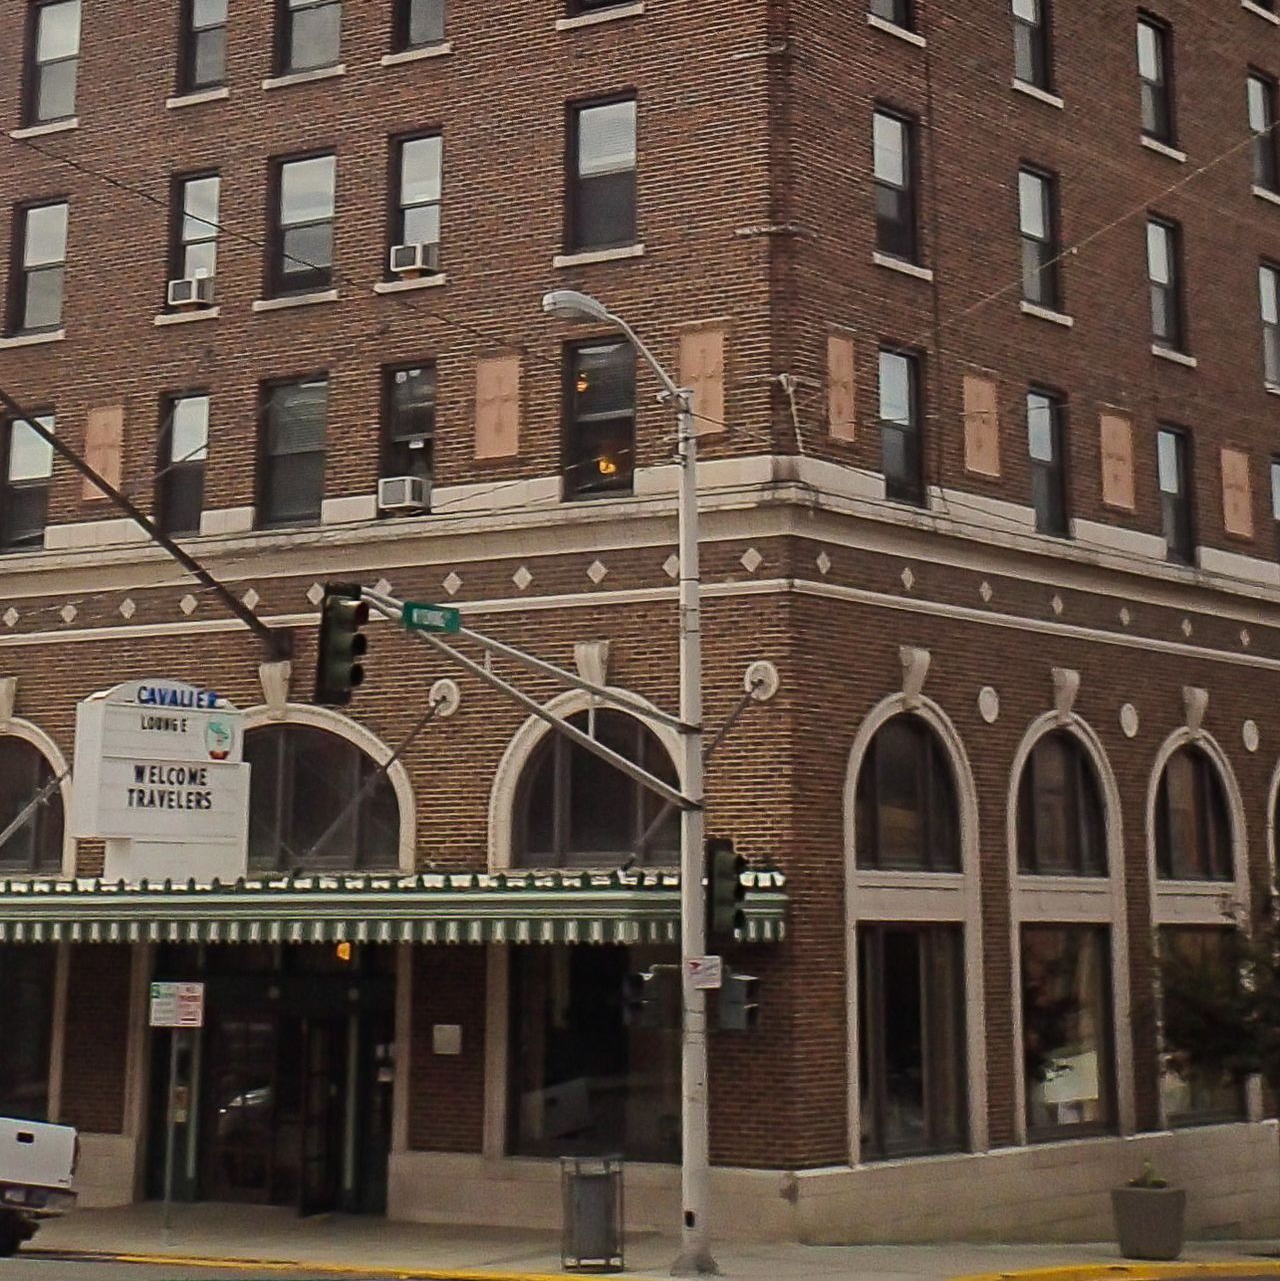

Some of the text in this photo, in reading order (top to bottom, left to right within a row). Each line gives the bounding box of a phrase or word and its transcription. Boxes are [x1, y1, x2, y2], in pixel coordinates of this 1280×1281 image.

[141, 715, 188, 732] LOUNGE
[135, 765, 207, 786] WELCOME
[128, 789, 212, 809] TRAVELERS
